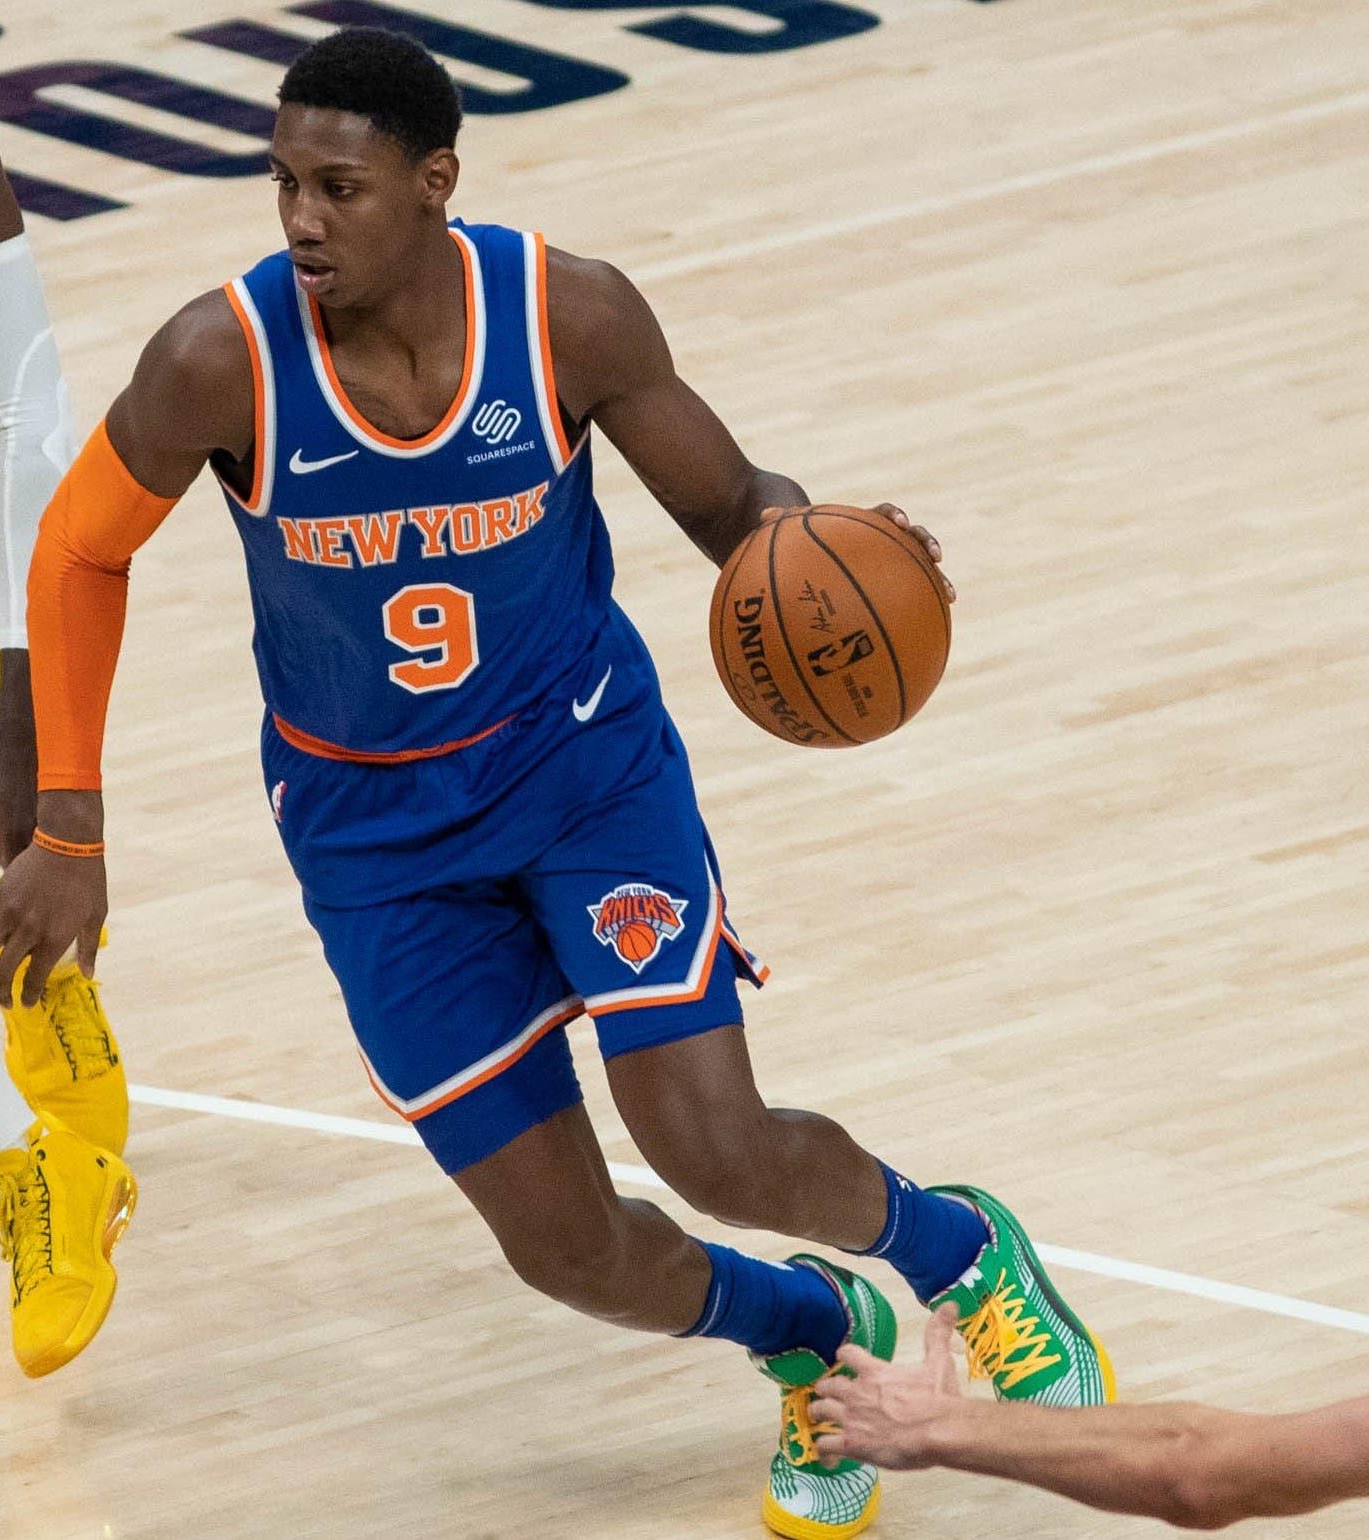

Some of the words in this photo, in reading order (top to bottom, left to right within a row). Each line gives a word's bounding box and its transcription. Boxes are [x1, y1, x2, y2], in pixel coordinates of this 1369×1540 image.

[467, 440, 535, 464] SQUARESPACE
[276, 510, 408, 569] NEW
[410, 482, 550, 559] YORK
[382, 583, 480, 695] 9
[734, 595, 829, 742] SPALDING
[596, 893, 681, 935] KNICKS
